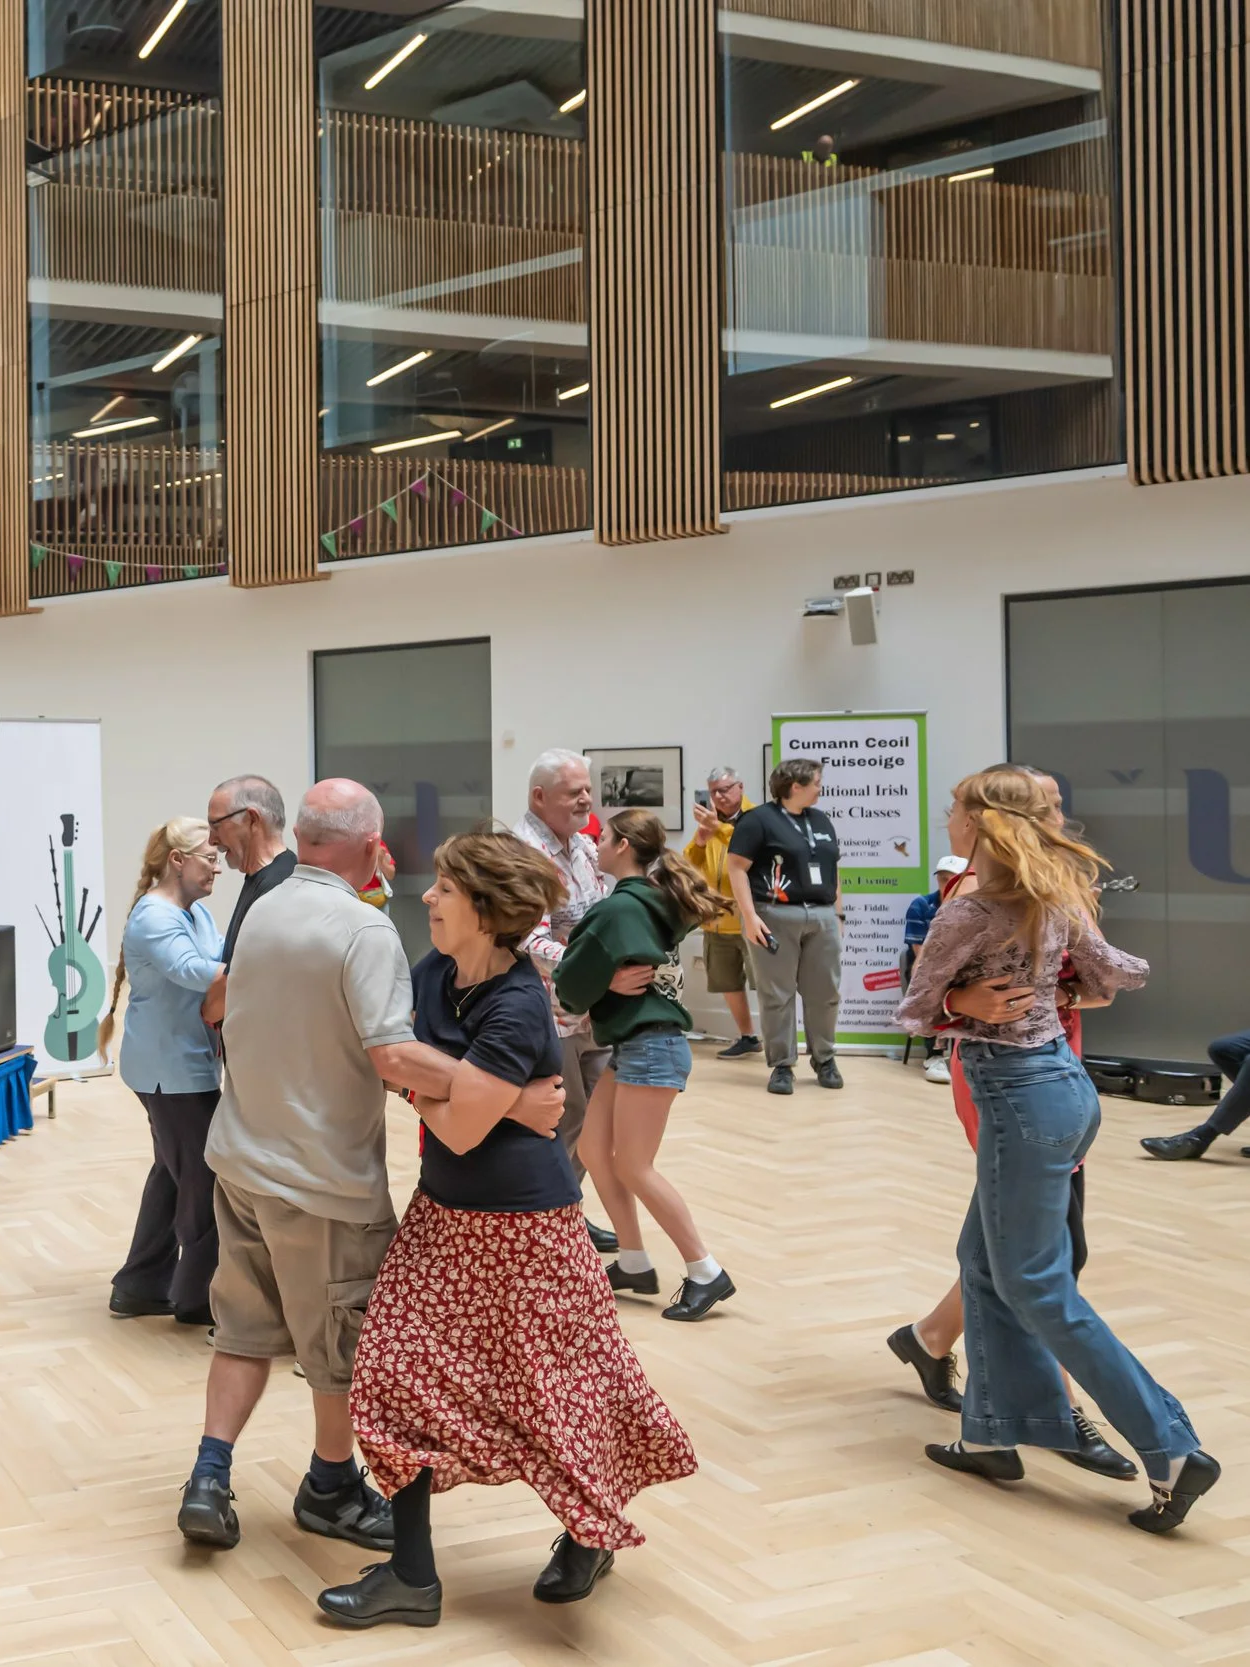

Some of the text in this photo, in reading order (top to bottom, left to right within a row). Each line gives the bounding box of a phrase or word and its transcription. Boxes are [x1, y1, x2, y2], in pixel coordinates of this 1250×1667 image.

[789, 736, 909, 750] Cumann Ceoil
[821, 755, 905, 769] Fuiseoige
[819, 784, 908, 797] ditional Irish
[825, 806, 901, 819] sic Classes
[857, 876, 898, 886] Evening
[864, 904, 889, 912] Fiddle
[844, 918, 862, 927] anjo
[870, 918, 906, 926] Mandoli
[845, 945, 868, 954] Pipes
[876, 945, 899, 954] Harp
[865, 959, 893, 967] Guitar
